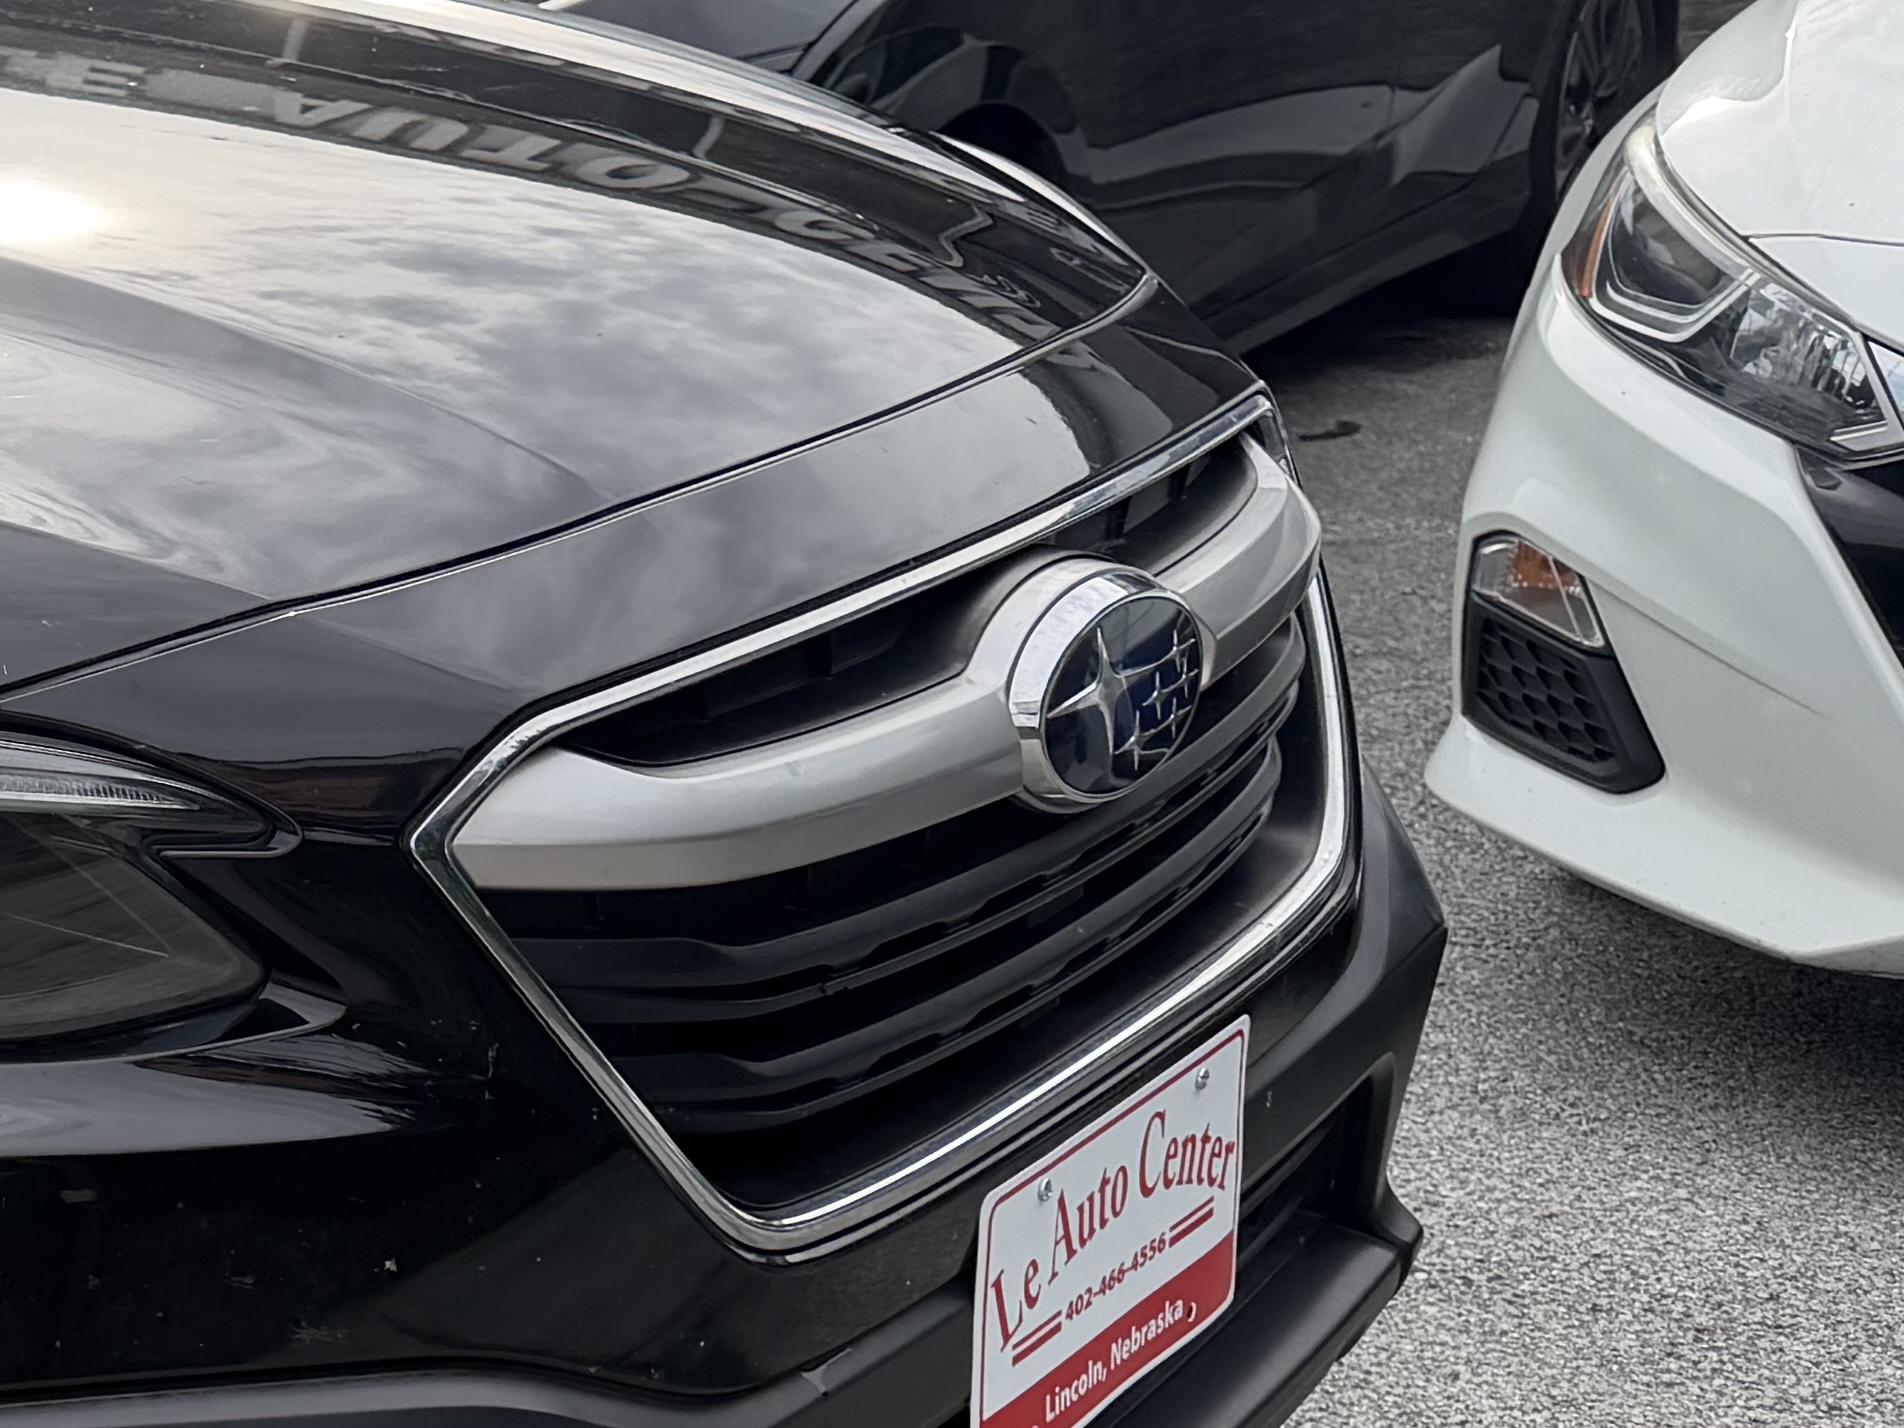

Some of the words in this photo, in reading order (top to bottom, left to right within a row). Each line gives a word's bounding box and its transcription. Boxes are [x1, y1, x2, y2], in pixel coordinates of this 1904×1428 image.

[990, 1258, 1041, 1353] Le
[1048, 1165, 1129, 1286] Auto
[1140, 1109, 1235, 1199] Center
[1065, 1231, 1167, 1322] 402-466-4556
[1045, 1359, 1107, 1422] Lincoln,
[1110, 1299, 1183, 1371] Nebraska
